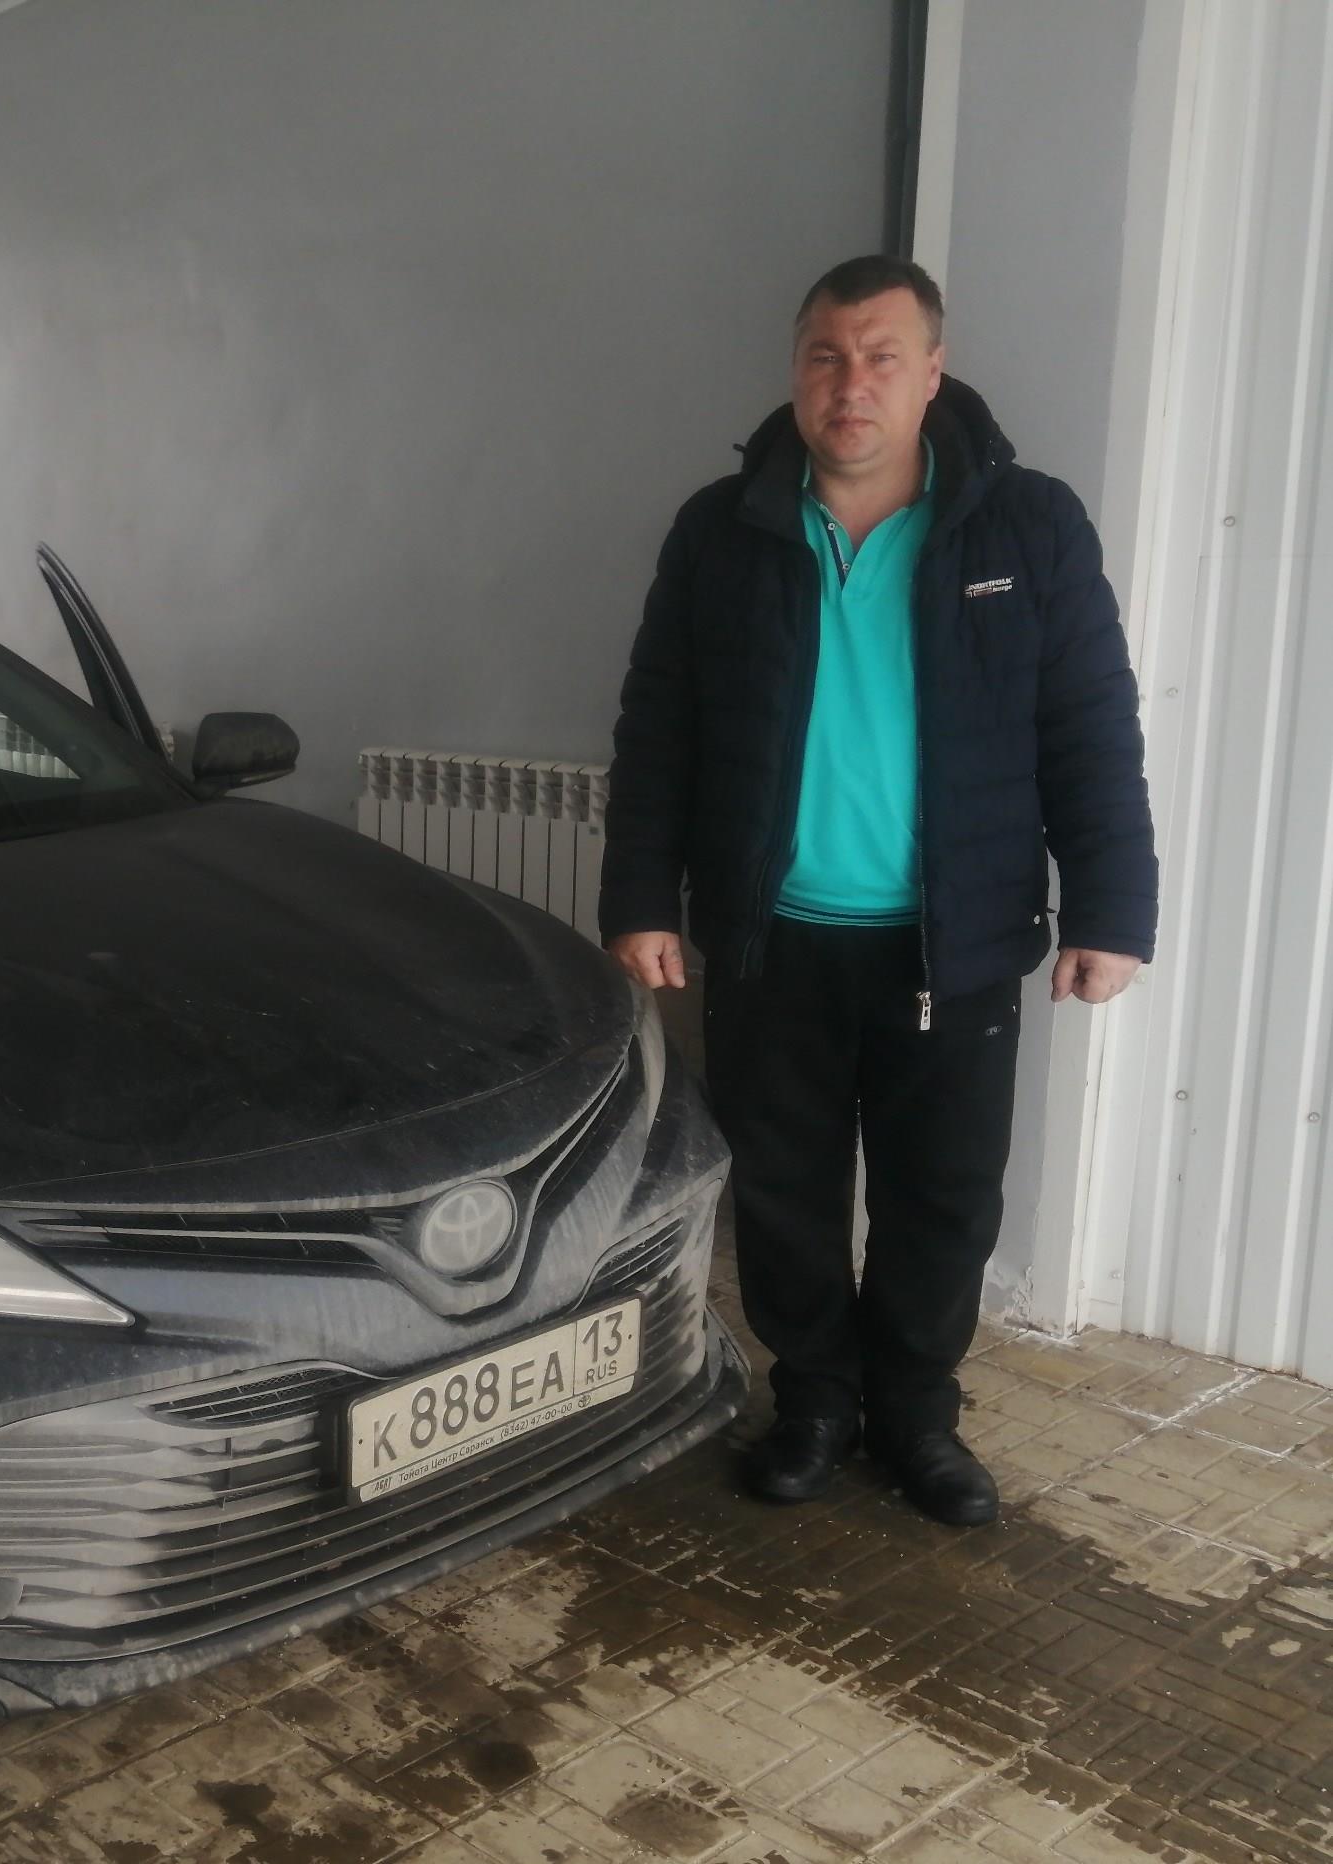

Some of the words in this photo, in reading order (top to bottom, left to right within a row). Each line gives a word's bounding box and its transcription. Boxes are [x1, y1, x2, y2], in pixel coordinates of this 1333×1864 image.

[581, 1311, 623, 1362] 13
[586, 1360, 618, 1385] RUS
[431, 1452, 458, 1469] Центр
[459, 1436, 494, 1456] Саранск
[500, 1419, 529, 1440] (8342)
[530, 1402, 573, 1427] 47-00-00
